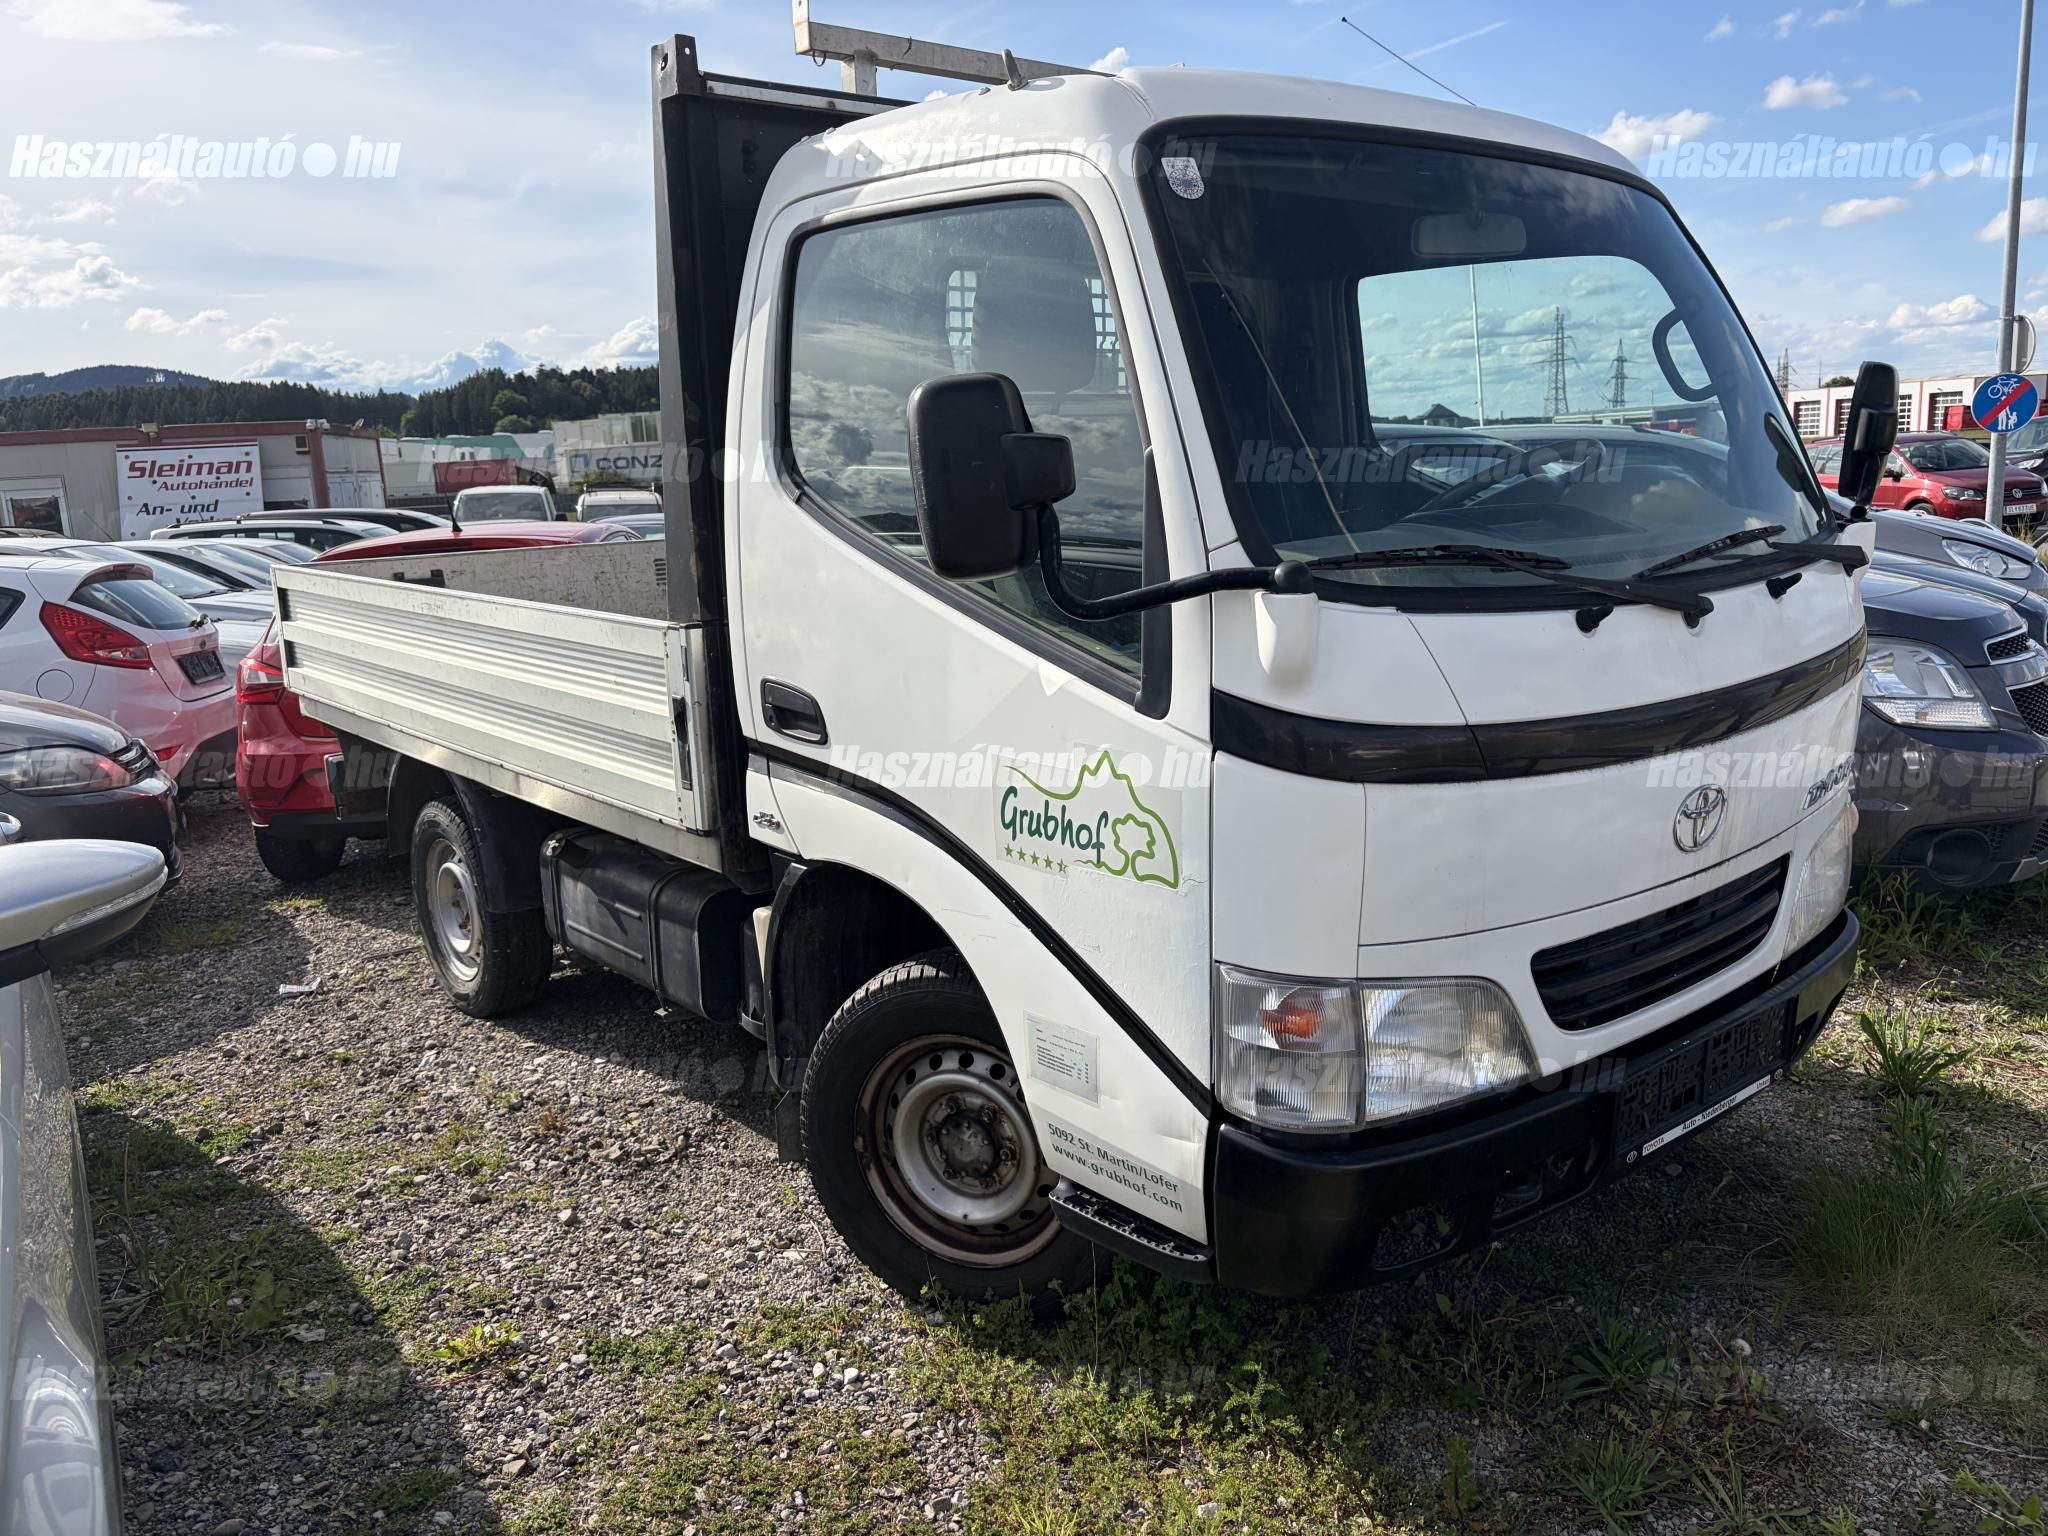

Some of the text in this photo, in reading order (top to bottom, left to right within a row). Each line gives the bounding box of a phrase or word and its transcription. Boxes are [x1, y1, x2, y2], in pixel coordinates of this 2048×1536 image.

[127, 458, 253, 479] Sleiman
[157, 477, 254, 492] Autohandel
[136, 499, 219, 516] An- und
[1001, 785, 1109, 865] Grubhof
[1681, 1118, 1697, 1132] Auto
[1048, 1122, 1179, 1193] 5092 St. Martin/Lofer
[1052, 1143, 1183, 1214] www.grubhof.com
